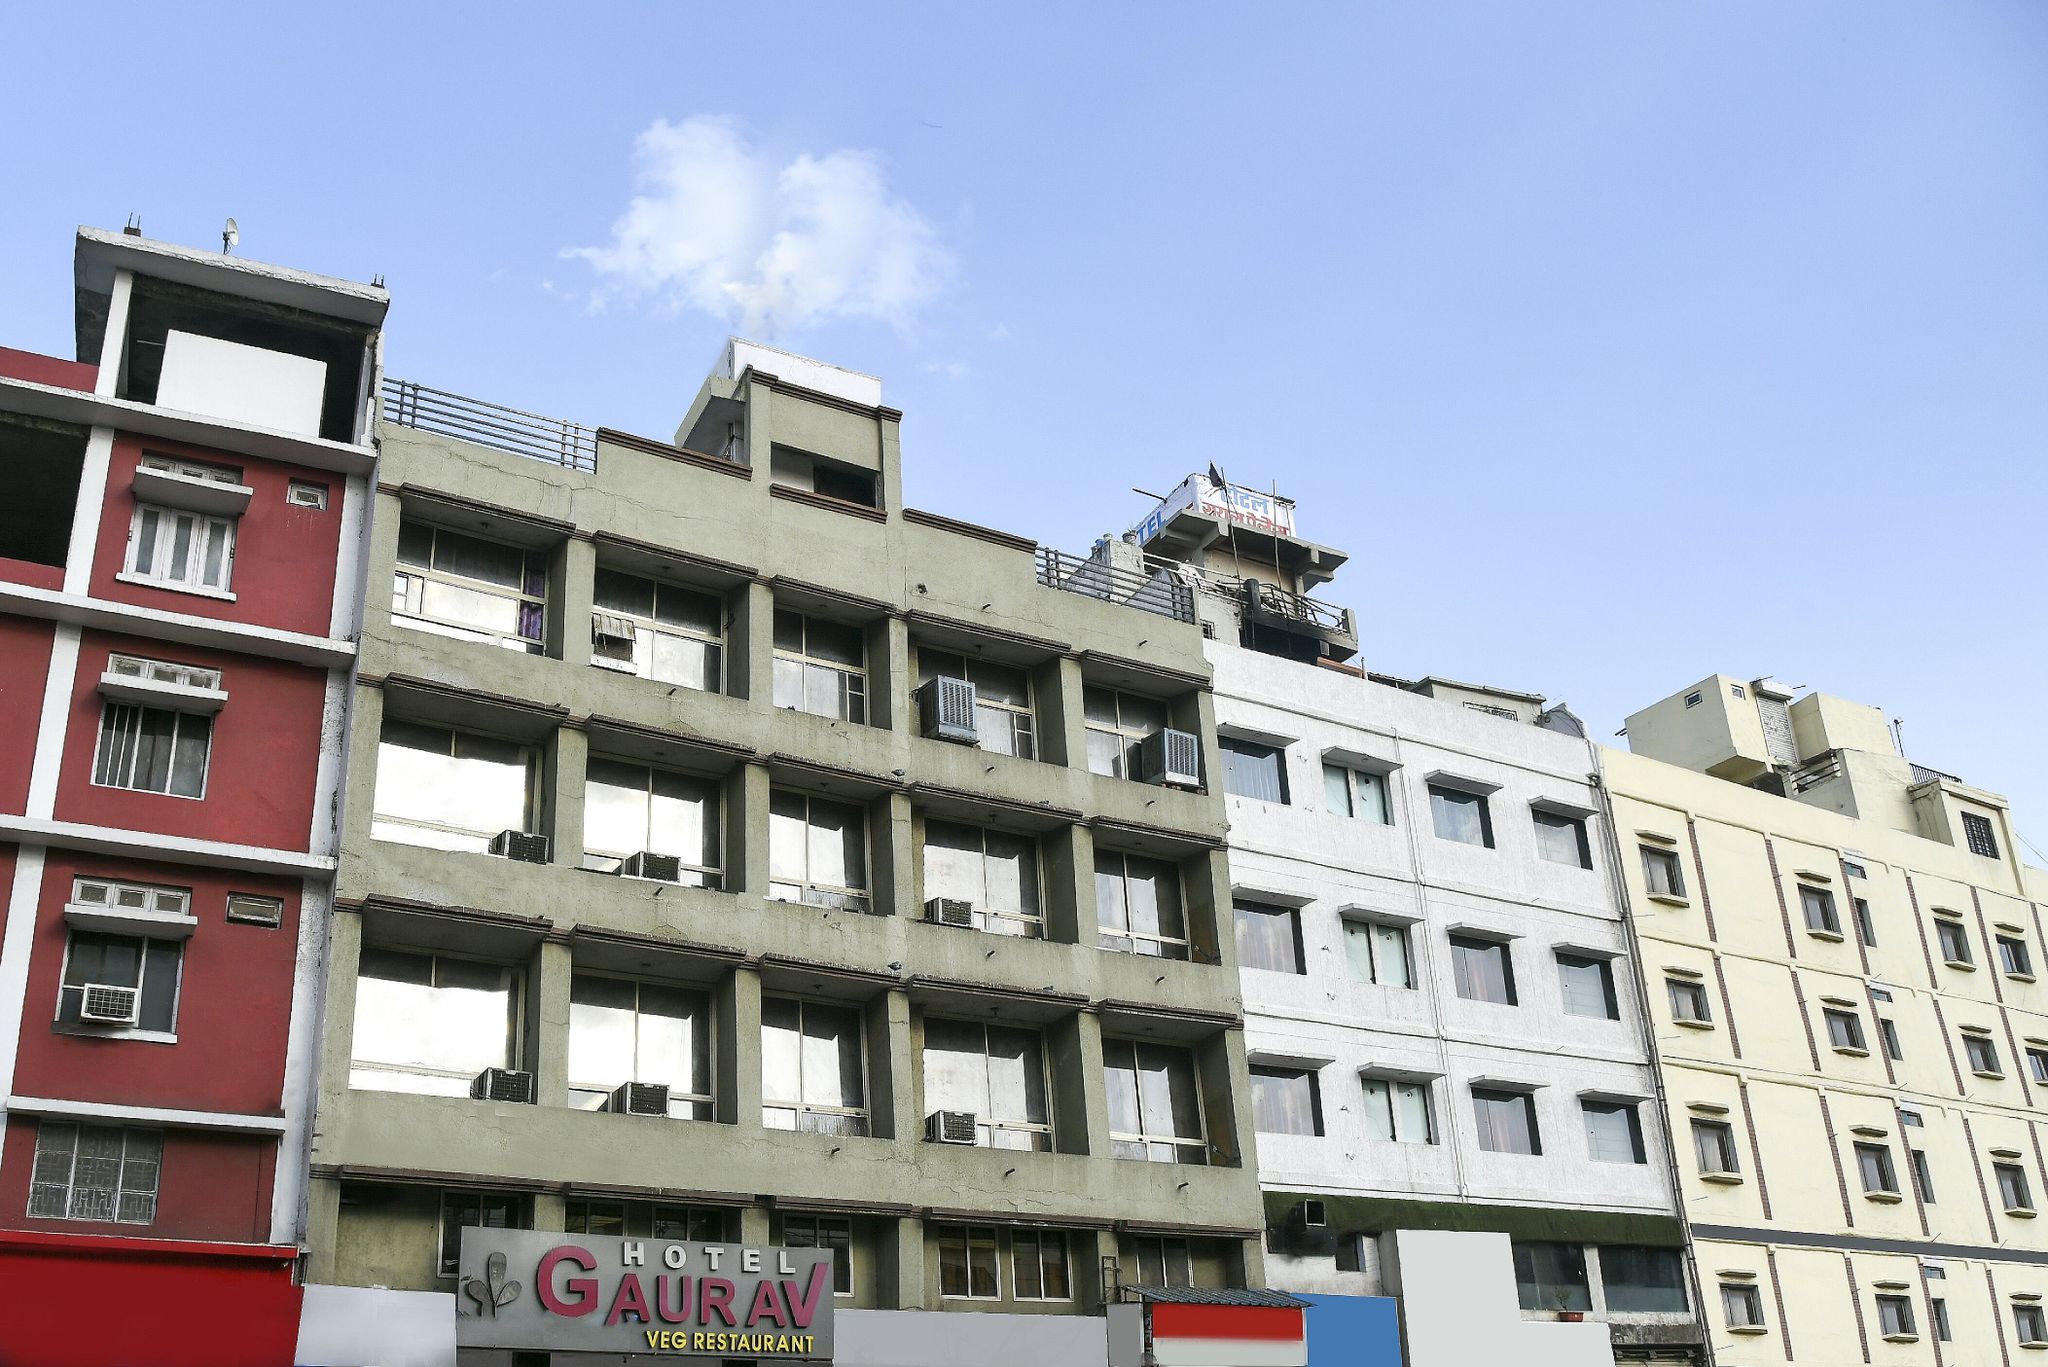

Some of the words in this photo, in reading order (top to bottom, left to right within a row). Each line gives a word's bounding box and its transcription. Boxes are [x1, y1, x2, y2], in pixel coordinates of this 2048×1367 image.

[622, 1241, 796, 1274] HOTEL
[536, 1245, 829, 1328] GAURAV
[646, 1330, 687, 1350] VEG
[694, 1332, 814, 1354] RESTAURANT
